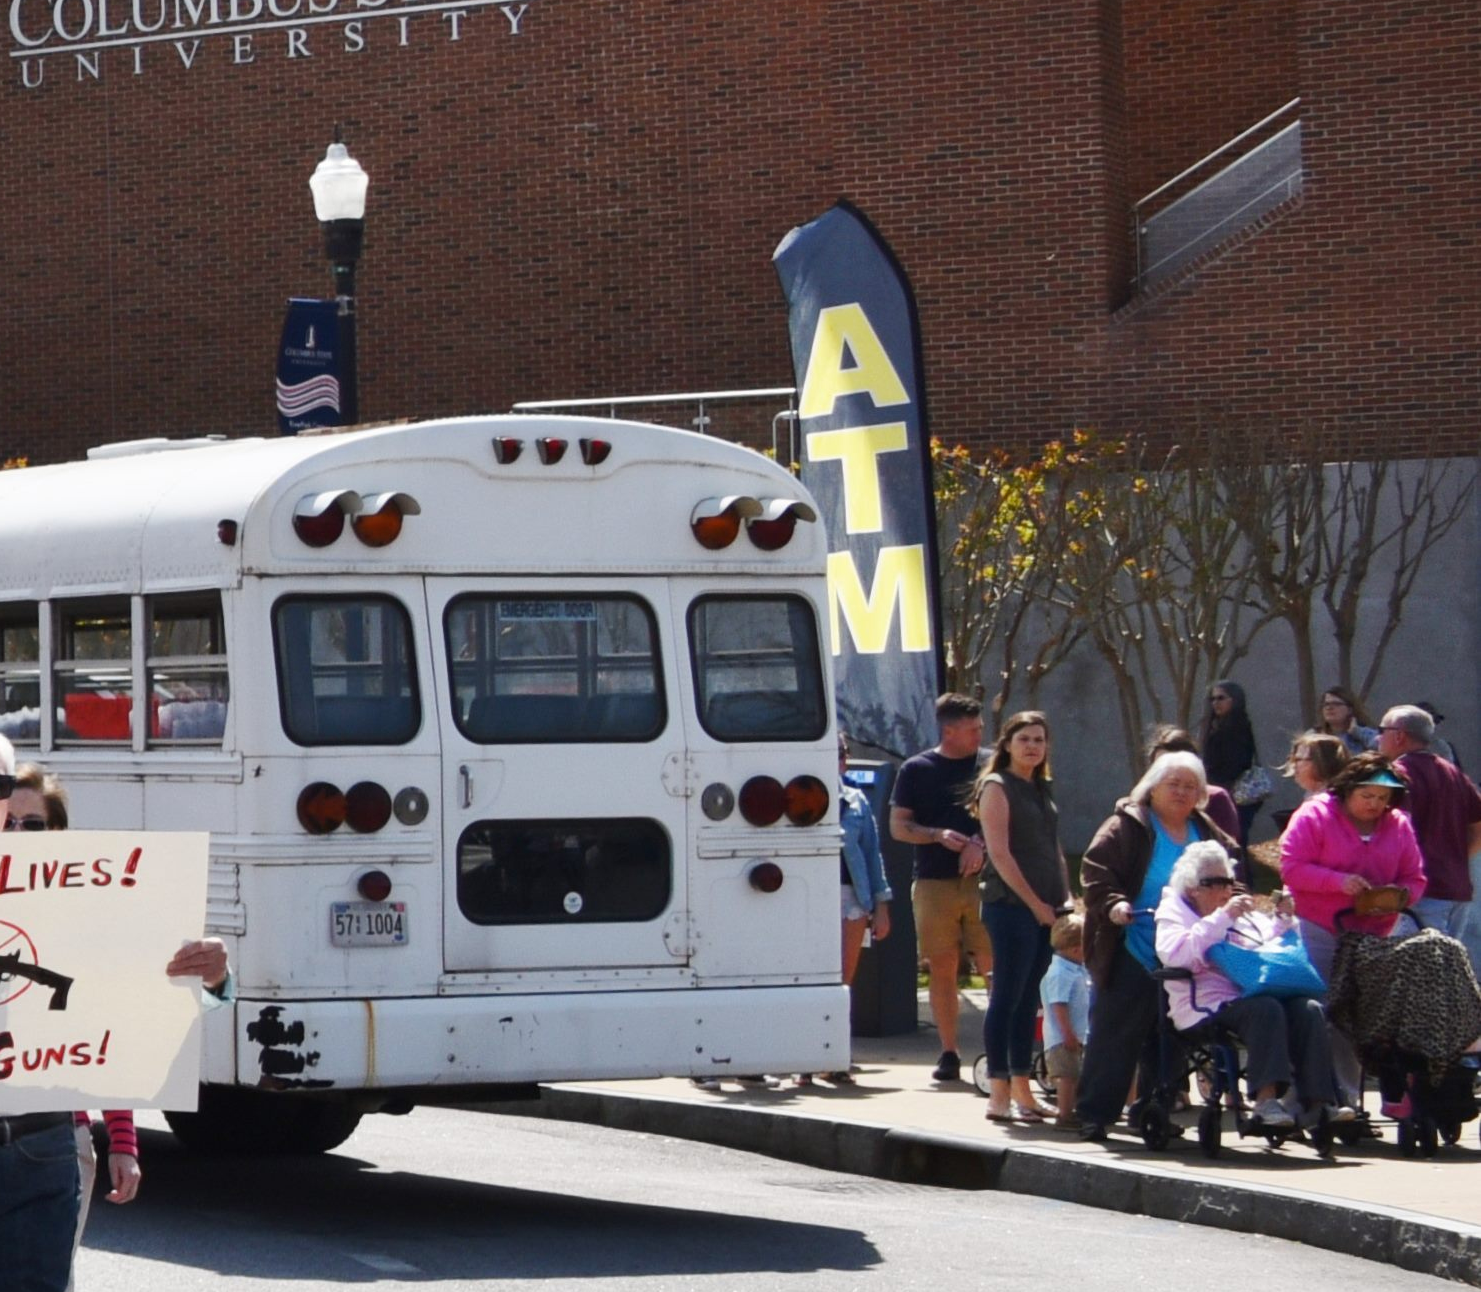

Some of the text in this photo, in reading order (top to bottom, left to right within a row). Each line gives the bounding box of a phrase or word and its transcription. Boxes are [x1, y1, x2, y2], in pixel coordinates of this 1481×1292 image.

[20, 5, 529, 88] UNIVERSITY
[799, 302, 931, 656] ATM
[336, 913, 354, 936] 57
[366, 913, 403, 936] 1004
